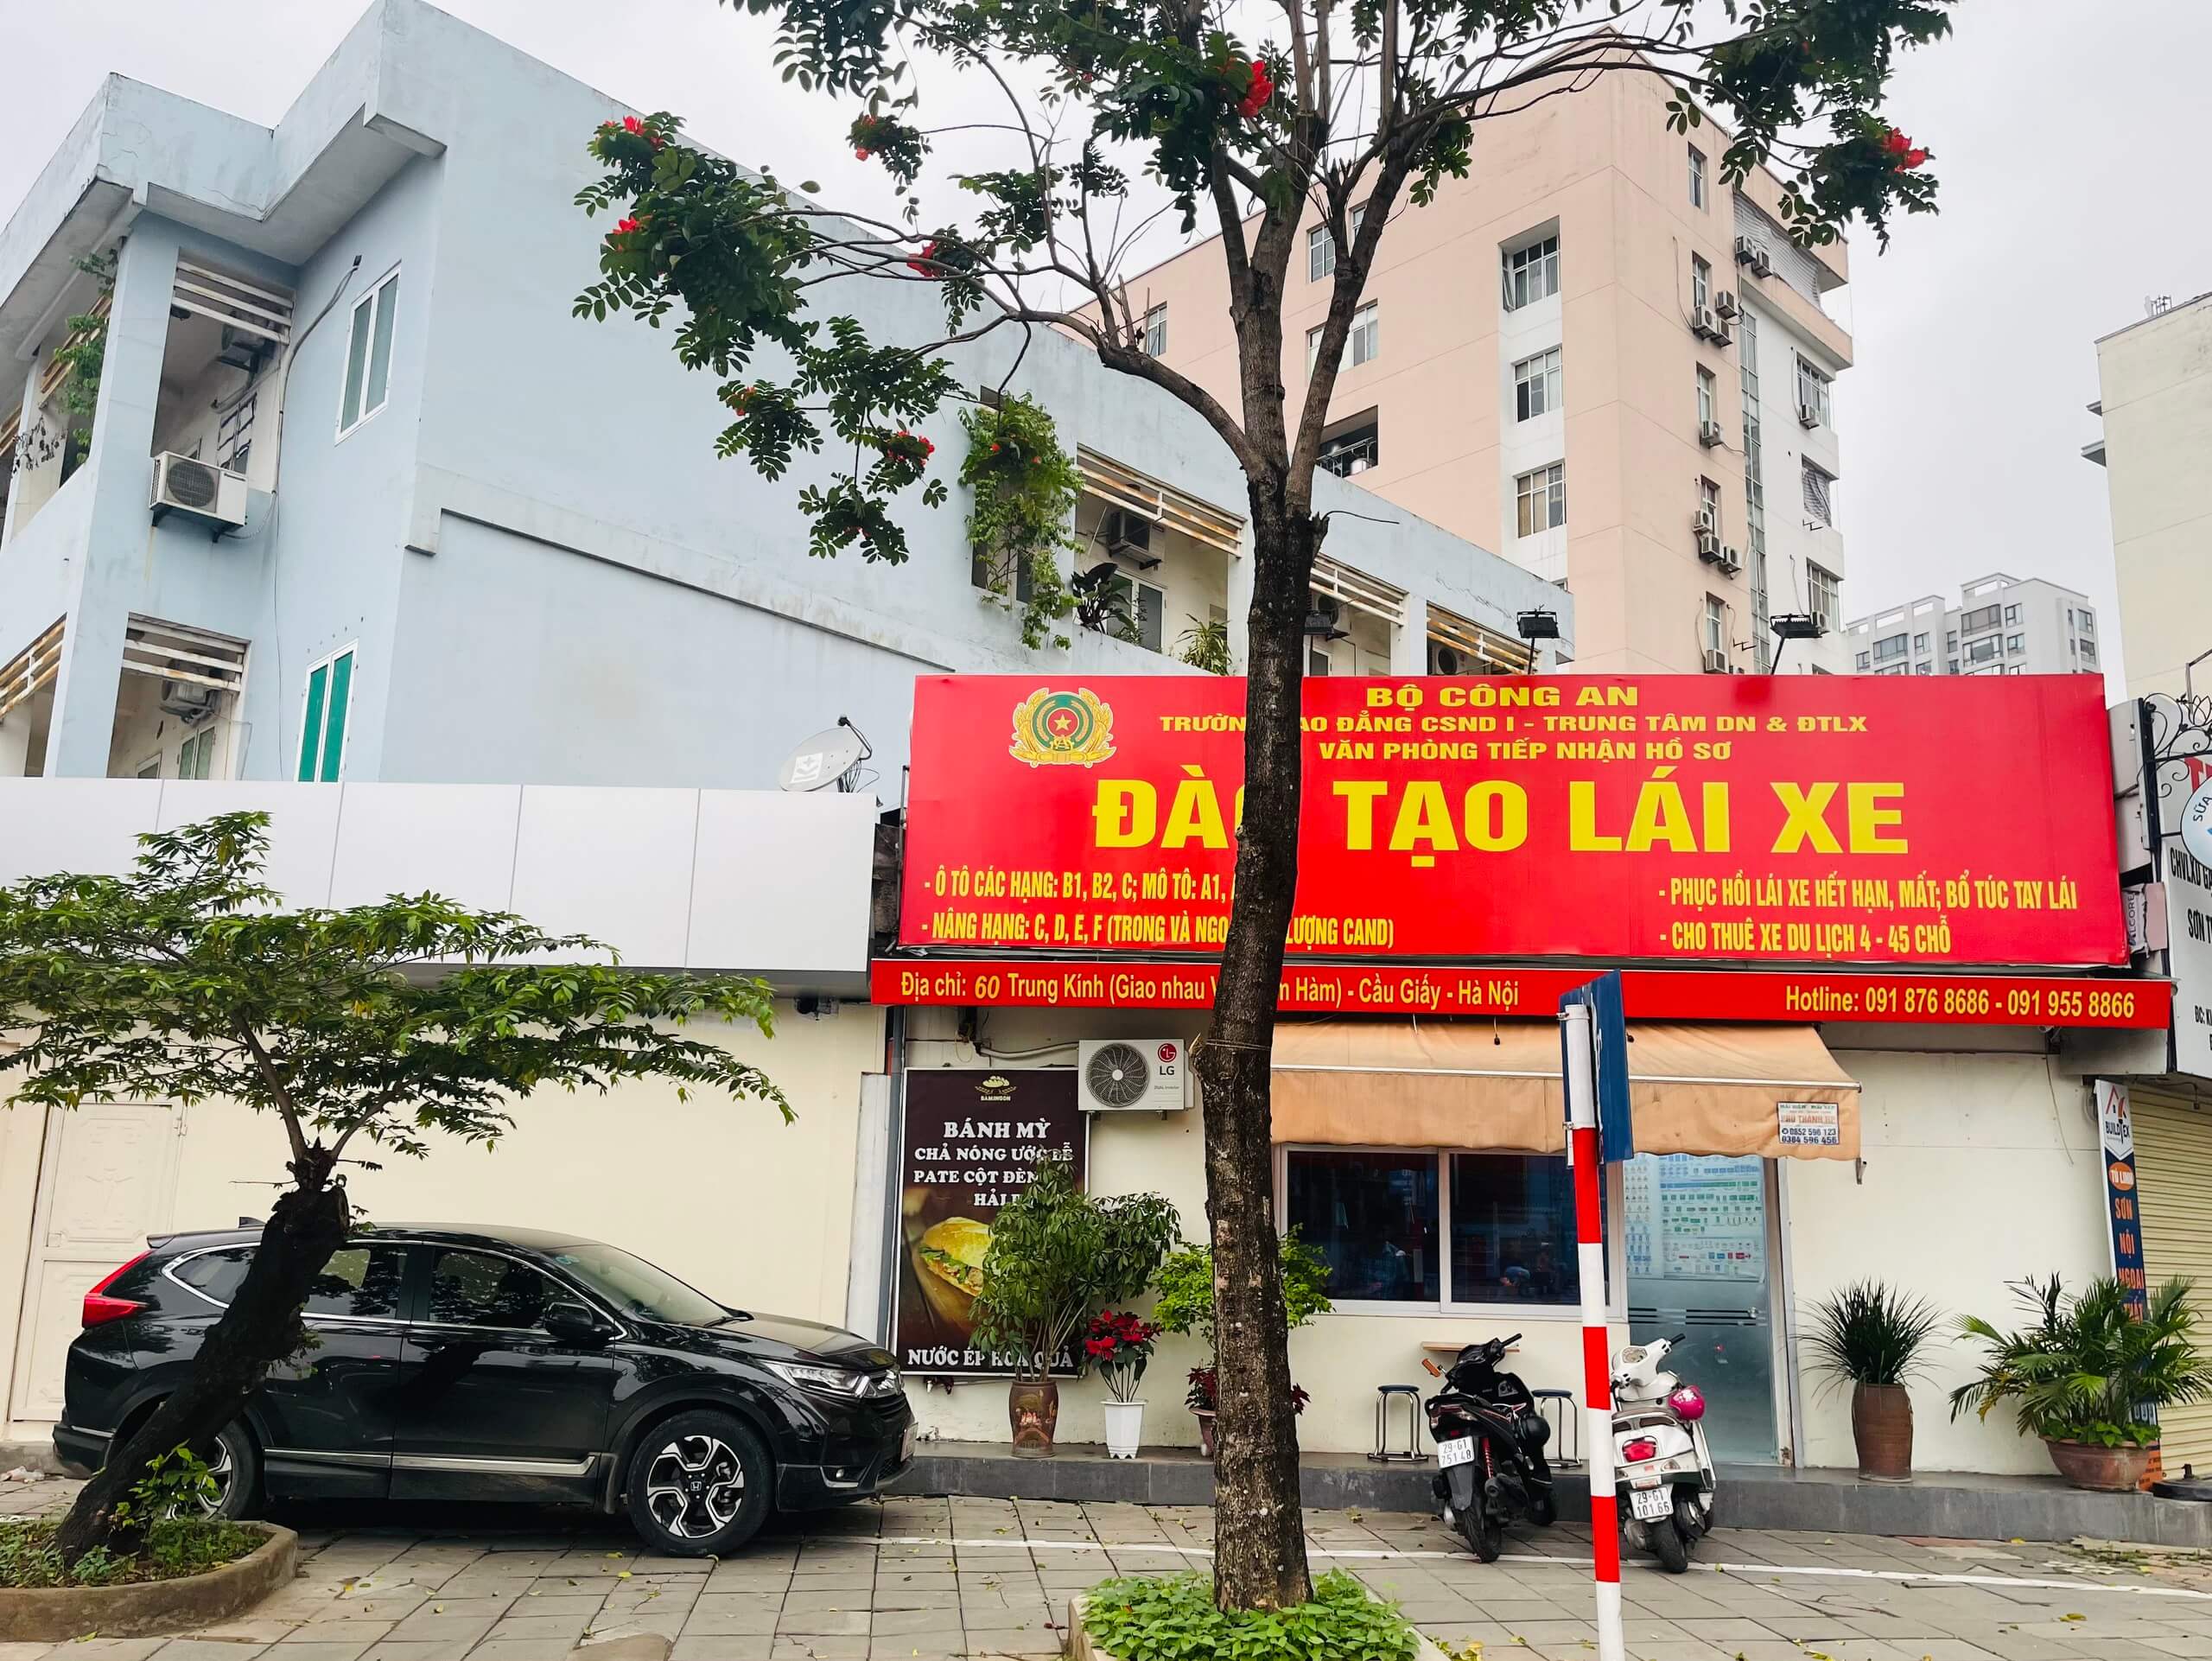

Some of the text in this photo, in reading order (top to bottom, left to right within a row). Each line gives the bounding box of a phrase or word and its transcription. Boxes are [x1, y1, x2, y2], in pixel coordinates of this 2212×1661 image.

[1368, 684, 1637, 711] BỘ CÔNG AN
[1161, 713, 1246, 732] TRƯỜN
[1337, 708, 1413, 732] ĐẲNG
[1421, 716, 1496, 732] CSND
[1507, 716, 1514, 731] I
[1543, 716, 1636, 731] TRUNG
[1645, 714, 1707, 732] TÂM
[1716, 716, 1756, 732] DN
[1766, 716, 1787, 732] &
[1797, 716, 1866, 732] ĐTLX
[1319, 738, 1732, 762] VĂN PHÒNG TIẾP NHẬN HỒ SƠ
[1092, 765, 1908, 867] ĐÀ TẠO LÁI XE
[936, 865, 947, 896] Ô
[951, 869, 969, 897] TÔ
[974, 867, 1006, 897] CÁC
[1010, 871, 1058, 902] HẠNG:
[1063, 872, 1087, 901] B1,
[1092, 873, 1116, 901] B2,
[1122, 873, 1137, 902] C;
[1142, 868, 1167, 899] MÔ
[1173, 868, 1196, 900] TÔ:
[1201, 874, 1225, 903] A1,
[1671, 878, 1717, 912] PHỤC
[1722, 869, 1751, 906] HỒI
[1756, 874, 1783, 906] LÁI
[1788, 879, 1810, 907] XE
[1815, 872, 1847, 907] HẾT
[1852, 880, 1894, 913] HẠN,
[1898, 871, 1941, 911] MẤT;
[1946, 871, 1970, 908] BỔ
[1974, 878, 2009, 908] TÚC
[2013, 881, 2043, 908] TAY
[2048, 878, 2077, 909] LÁI
[932, 907, 976, 939] NÂNG
[982, 913, 1029, 945] HẠNG:
[1034, 916, 1049, 943] C,
[1054, 916, 1069, 944] D,
[1074, 916, 1088, 944] E,
[1094, 916, 1103, 940] F
[1108, 915, 1165, 944] (TRONG
[1171, 910, 1190, 943] VÀ
[1344, 919, 1393, 948] CAND)
[1672, 921, 1707, 950] CHO
[1711, 918, 1755, 951] THUÊ
[1759, 923, 1783, 951] XE
[1787, 923, 1810, 951] DU
[1815, 924, 1854, 958] LỊCH
[1860, 926, 1871, 951] 4
[1888, 926, 1910, 953] 45
[1915, 915, 1950, 953] CHỖ
[901, 972, 929, 999] Địa
[936, 972, 965, 996] chỉ:
[976, 976, 1000, 998] 60
[1007, 973, 1058, 1003] Trung
[1065, 974, 1103, 997] Kính
[1110, 975, 1155, 1003] (Giao
[1162, 976, 1205, 999] nhau
[1296, 977, 1342, 1008] Hàm)
[1359, 974, 1393, 1002] Cầu
[1401, 974, 1440, 1009] Giấy
[1459, 976, 1481, 1004] Hà
[1489, 981, 1517, 1010] Nội
[1787, 986, 1858, 1011] Hotline:
[1866, 987, 1896, 1012] 091
[1905, 988, 1937, 1013] 876
[1944, 989, 1988, 1014] 8686
[2008, 990, 2039, 1015] 091
[2049, 991, 2082, 1016] 955
[2088, 992, 2133, 1017] 8866
[1160, 1066, 1175, 1075] LG
[944, 1117, 1051, 1138] BÁNH MỲ
[914, 1142, 951, 1161] CHẢ
[957, 1145, 1007, 1161] NÓNG
[913, 1170, 959, 1183] PATE
[963, 1168, 998, 1186] CỘT
[2115, 1197, 2133, 1220] SƠN
[907, 1346, 958, 1366] NƯỚC
